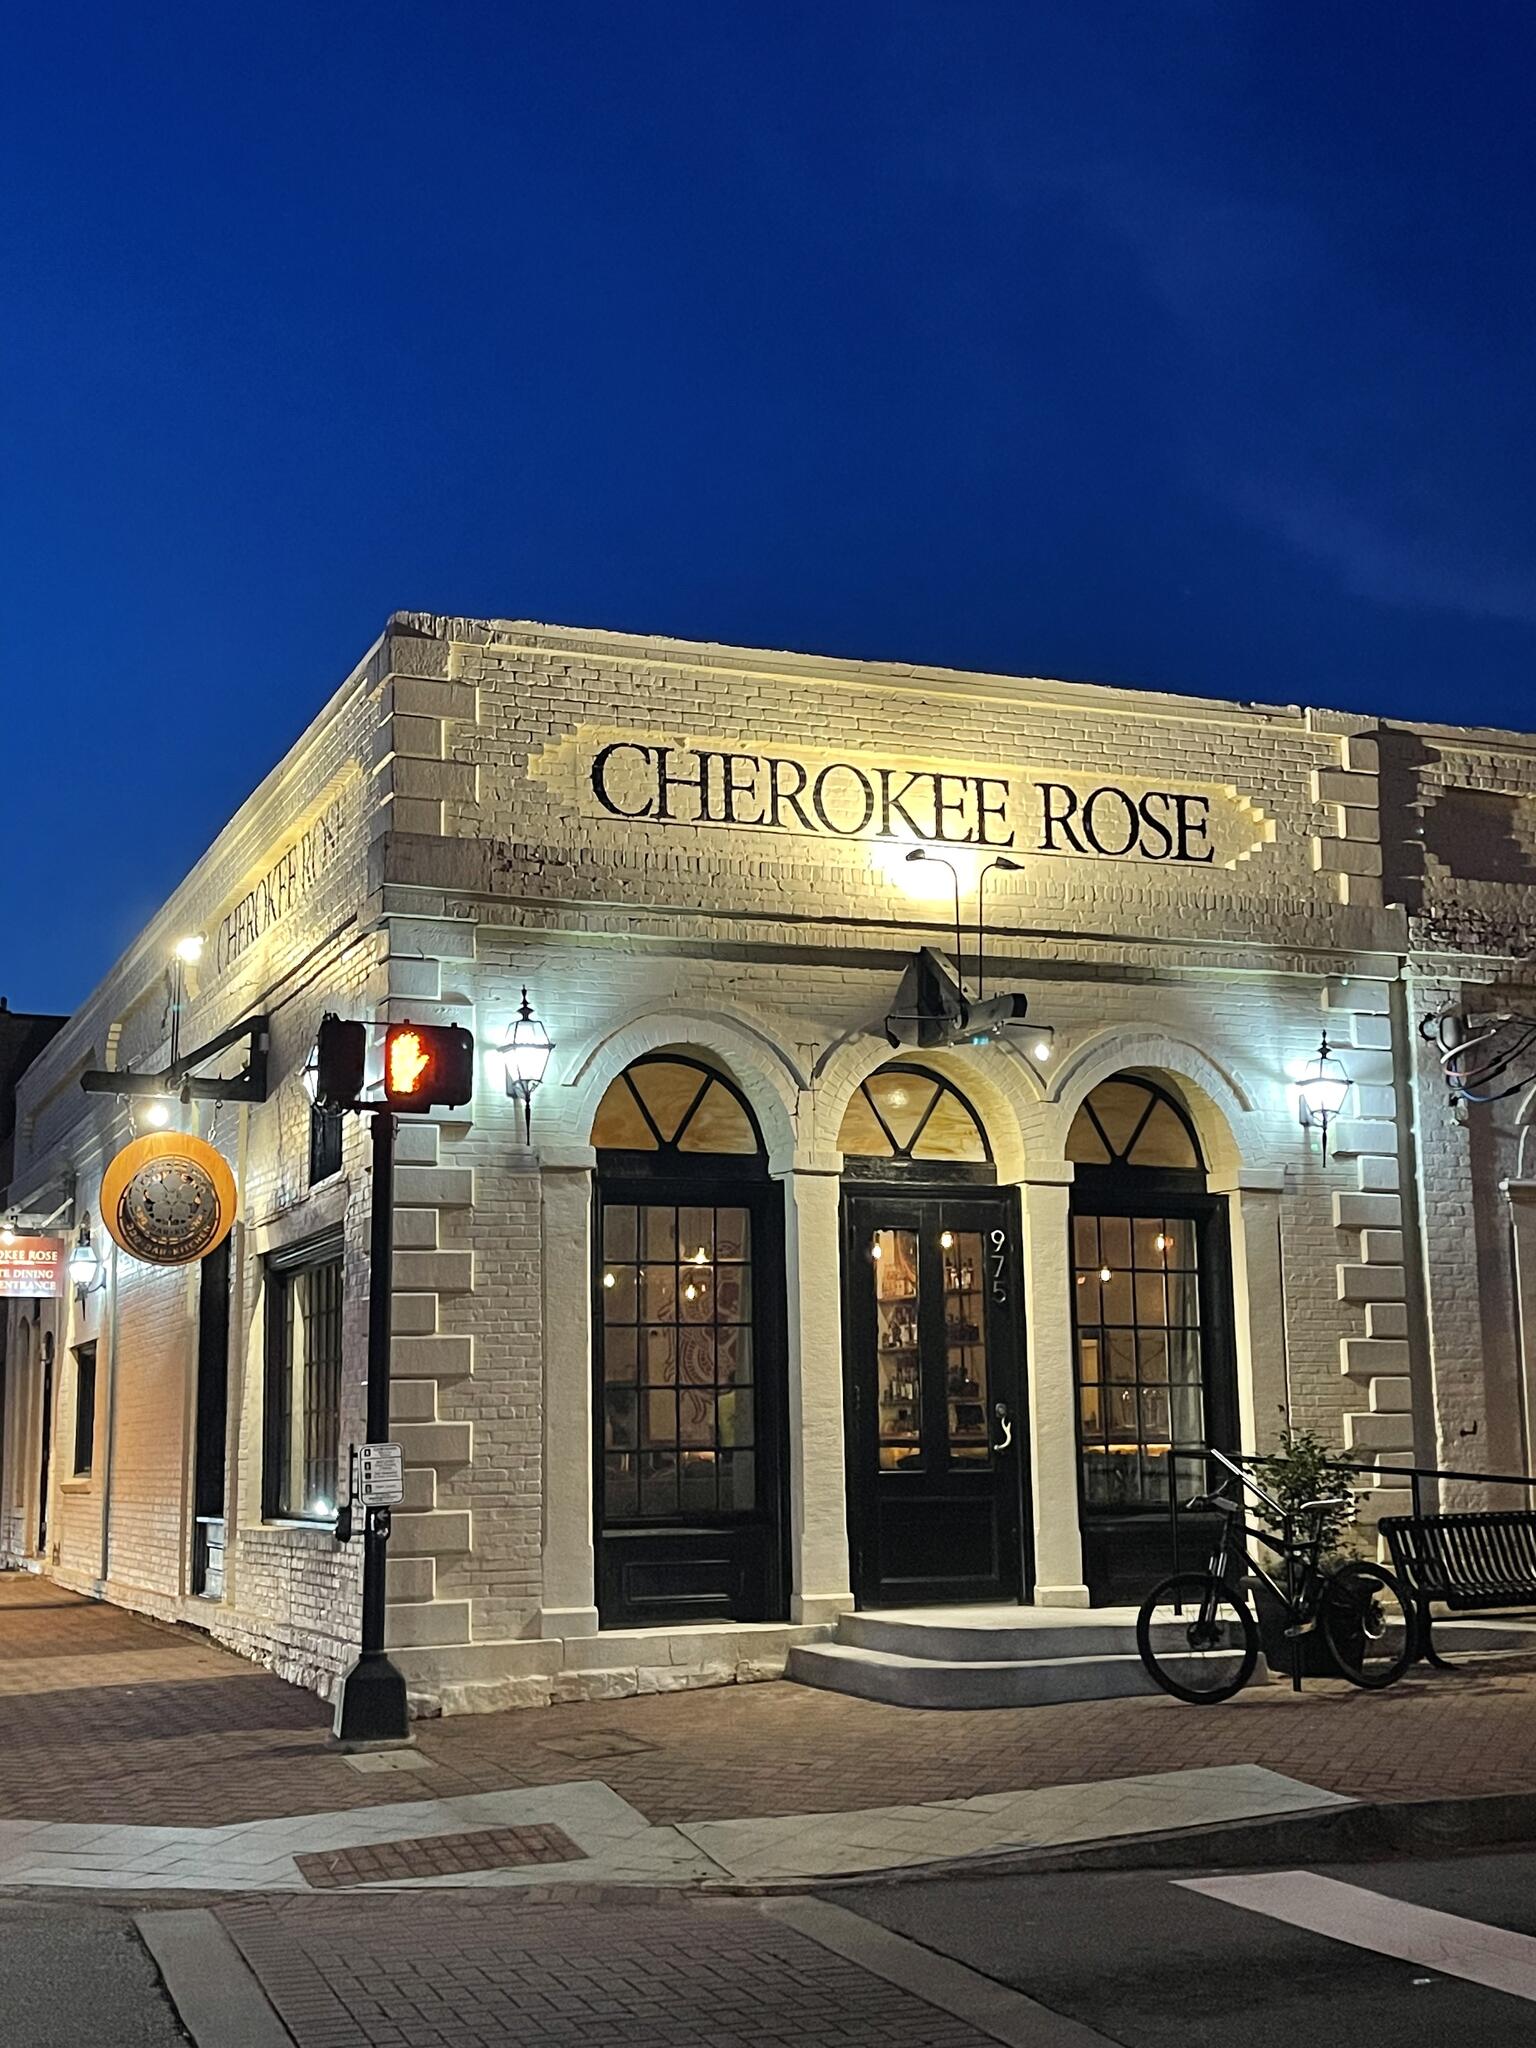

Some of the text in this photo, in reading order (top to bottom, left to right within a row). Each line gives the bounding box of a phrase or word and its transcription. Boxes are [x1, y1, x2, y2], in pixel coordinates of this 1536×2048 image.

[592, 743, 1214, 862] CHEROKEE ROSE
[218, 844, 298, 974] CHEROKEE
[13, 1269, 54, 1279] DINING
[28, 1250, 58, 1261] ROSE
[990, 1229, 1006, 1303] 975
